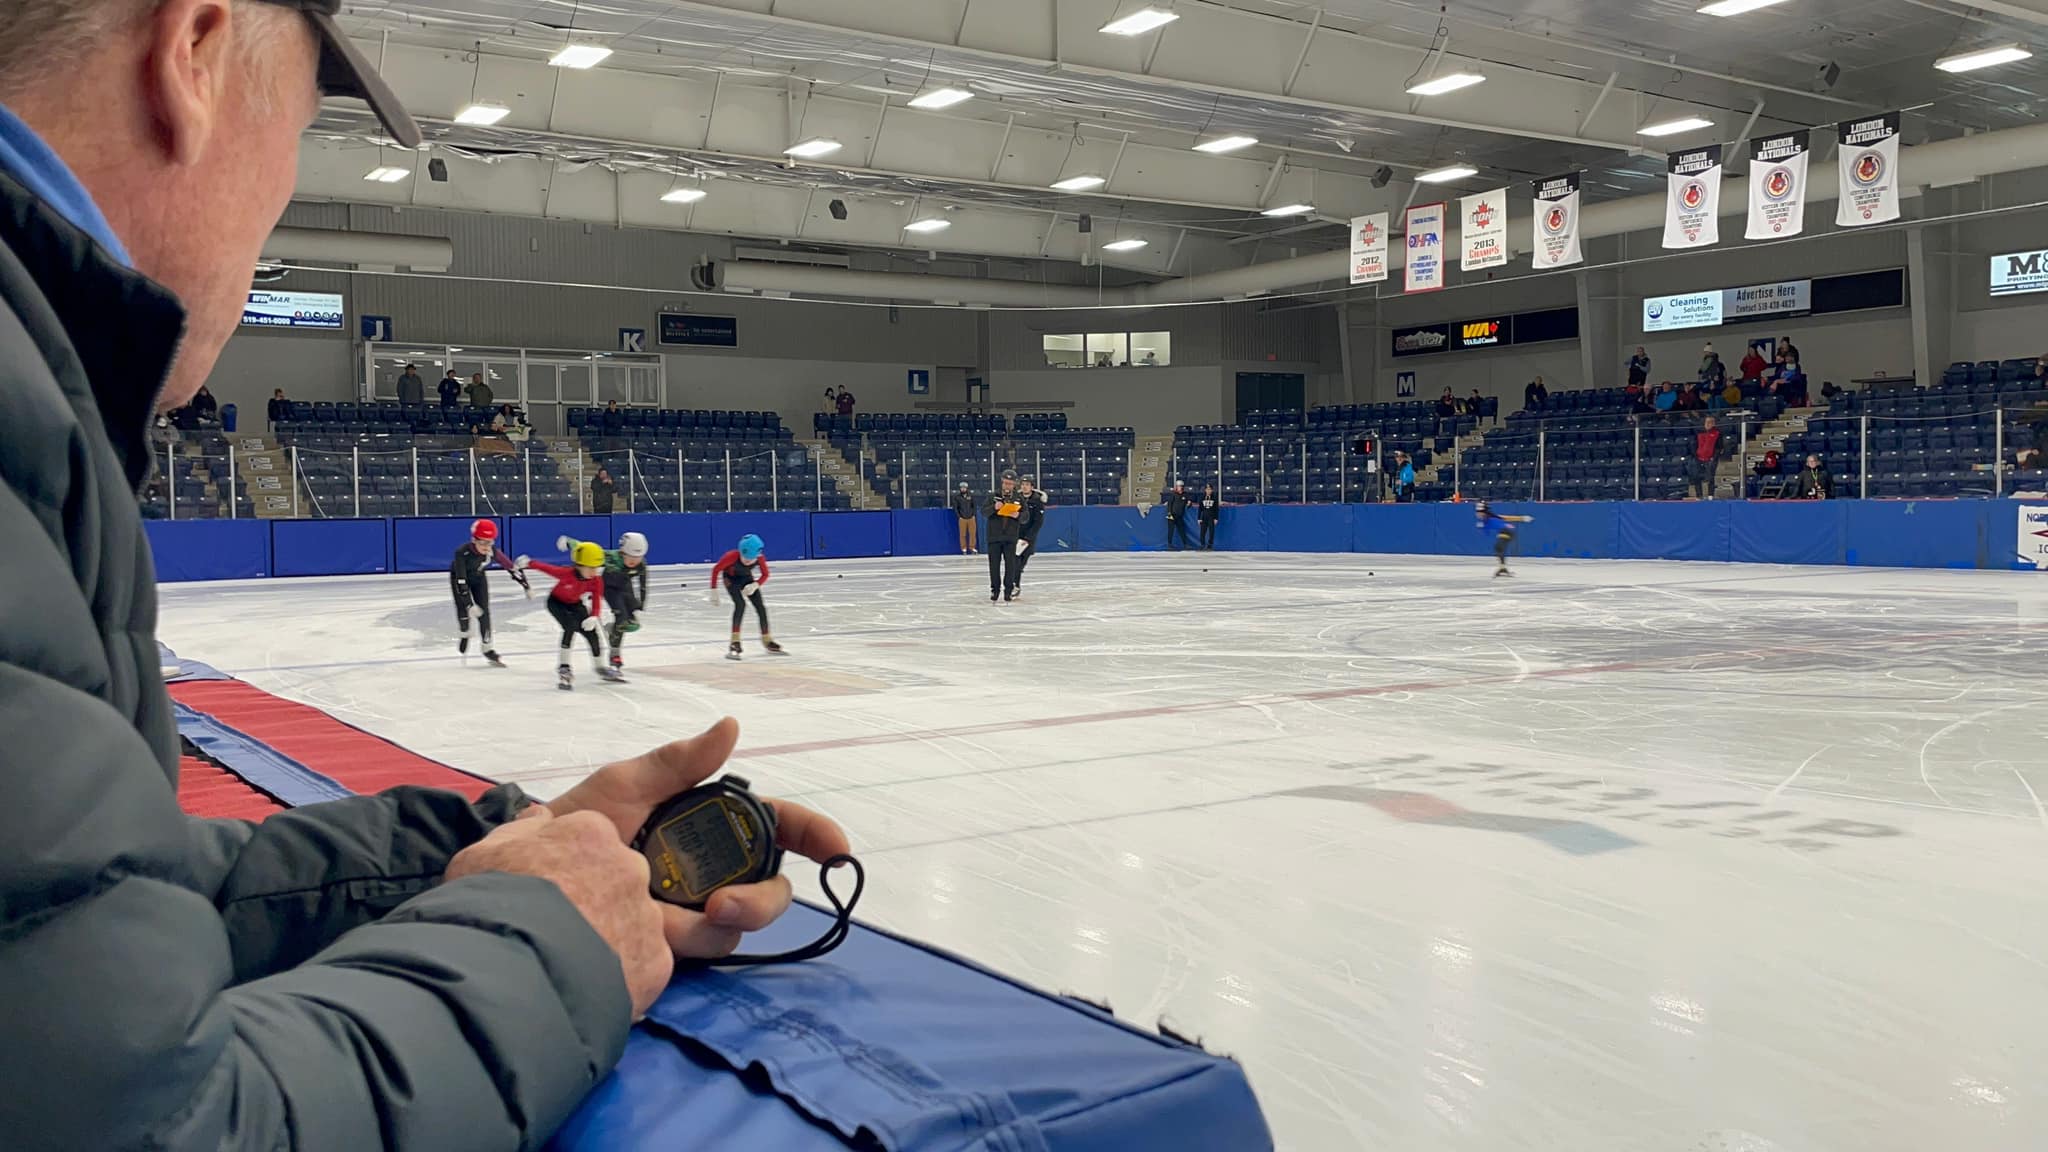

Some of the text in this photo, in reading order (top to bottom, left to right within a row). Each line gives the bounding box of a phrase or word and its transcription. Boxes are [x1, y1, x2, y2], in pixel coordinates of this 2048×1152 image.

[1851, 118, 1885, 134] LONDON
[1762, 136, 1794, 150] LONDON
[1845, 127, 1893, 144] NATIONALS
[1679, 152, 1707, 164] LONDON
[1757, 145, 1801, 160] NATIONALS
[1674, 160, 1713, 174] NATIONALS
[1539, 185, 1574, 200] NATIONALS
[1469, 245, 1499, 258] CHAMPS
[1474, 239, 1495, 249] 2013
[1356, 262, 1382, 273] CHAMPS
[1361, 256, 1380, 265] 2012
[1736, 285, 1796, 301] Advertise Here
[1670, 296, 1708, 307] Cleaning
[1684, 305, 1714, 313] Solutions
[1736, 303, 1757, 313] Contact
[370, 320, 384, 341] J
[1463, 322, 1489, 338] VIA
[623, 332, 642, 352] K
[1756, 342, 1772, 364] N
[913, 373, 925, 391] L
[1399, 375, 1415, 394] M
